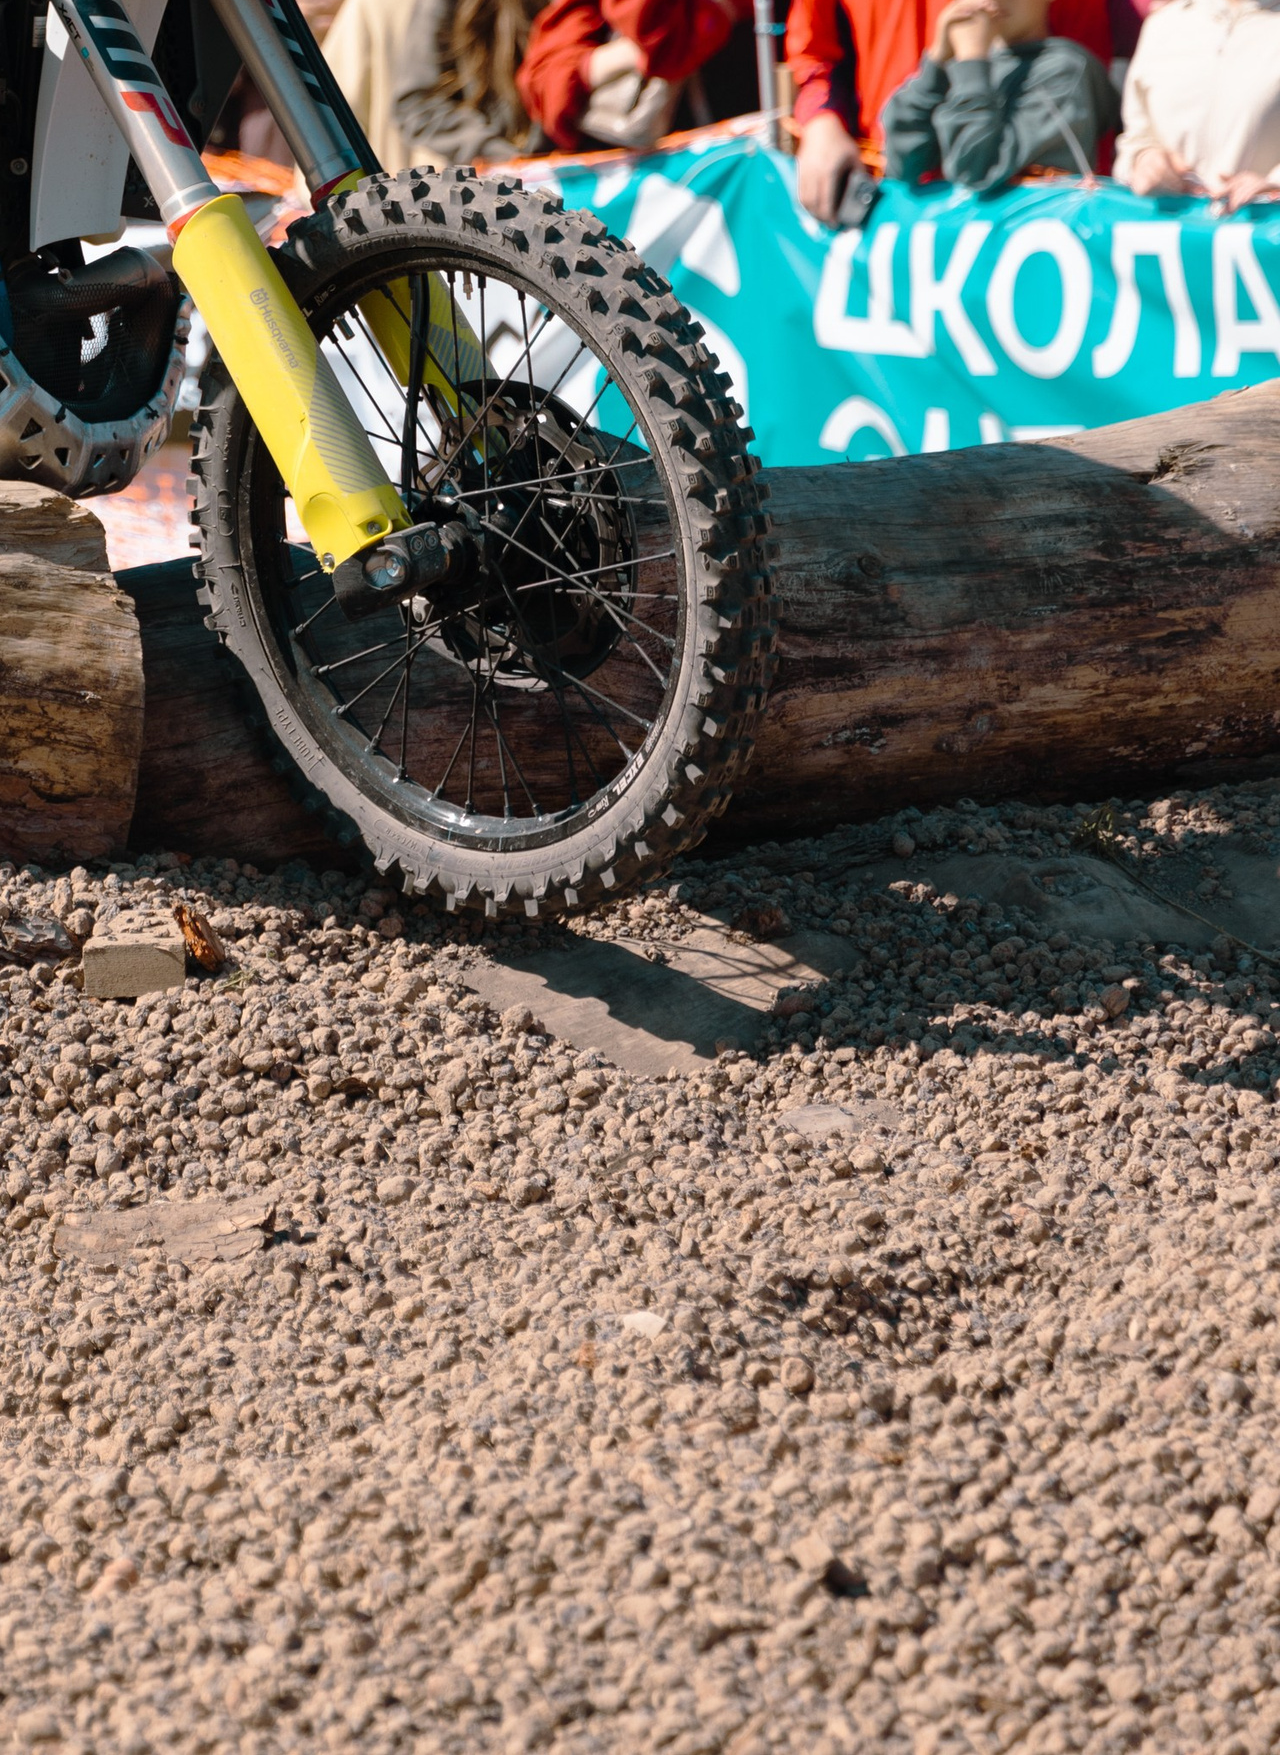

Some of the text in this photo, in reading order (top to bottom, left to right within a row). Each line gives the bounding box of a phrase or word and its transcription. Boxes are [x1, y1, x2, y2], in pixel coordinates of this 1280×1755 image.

[58, 3, 81, 40] XACT
[258, 304, 300, 370] Husqvarna
[612, 752, 646, 796] EXCEL
